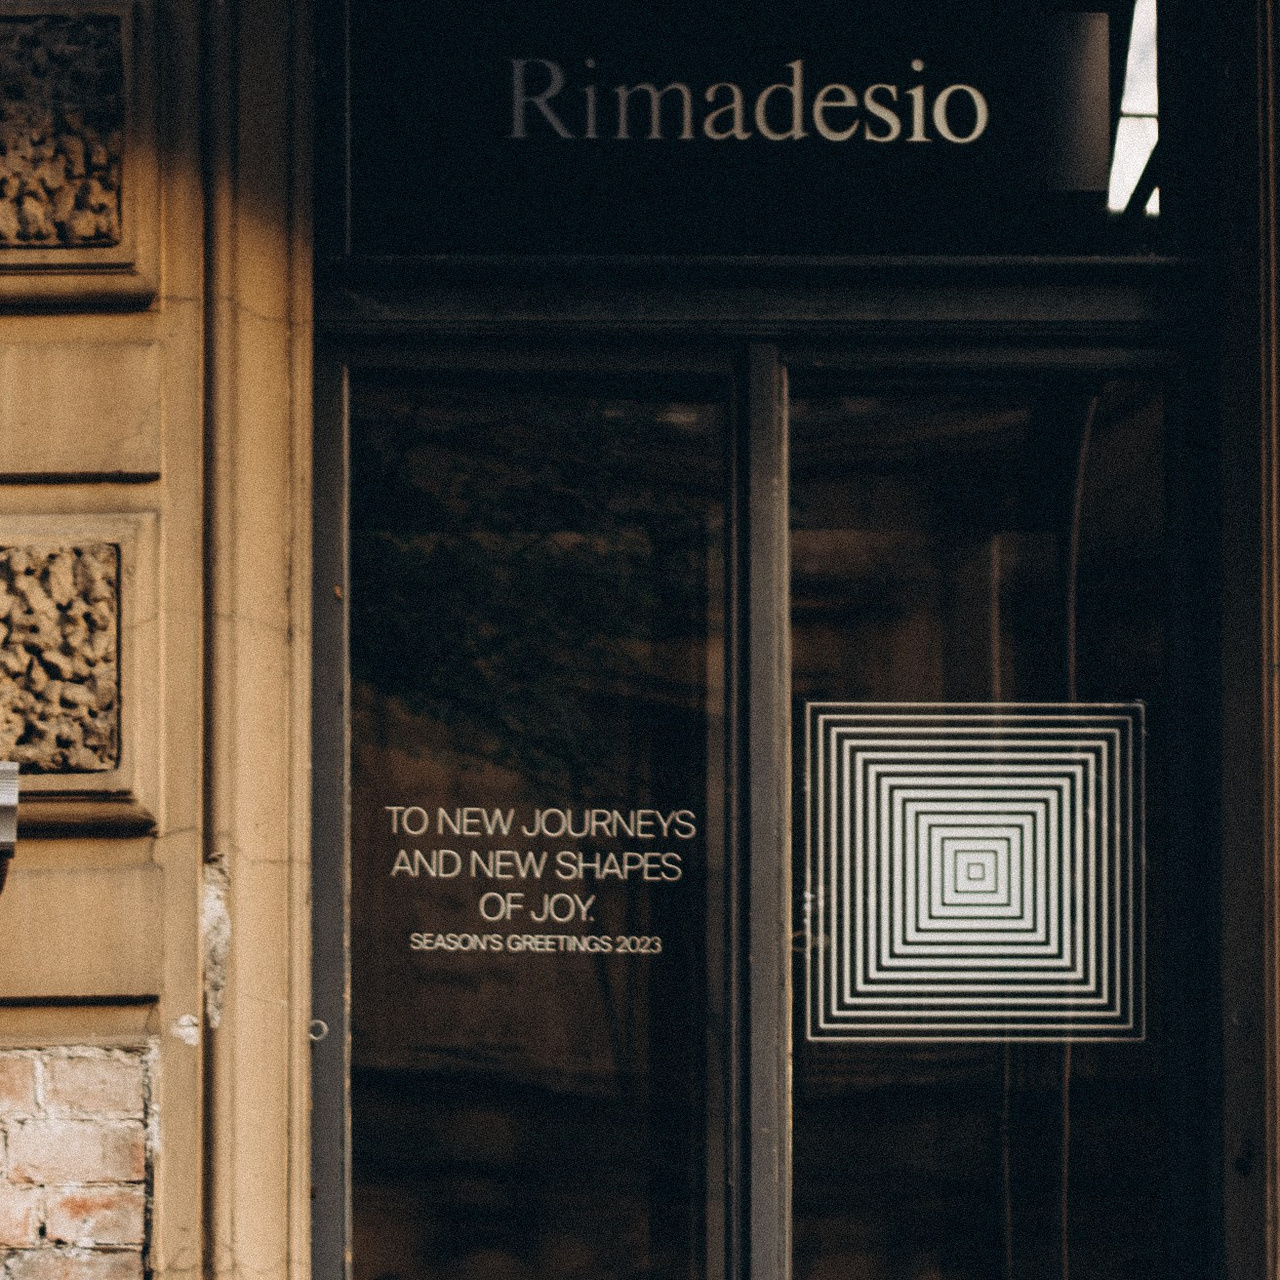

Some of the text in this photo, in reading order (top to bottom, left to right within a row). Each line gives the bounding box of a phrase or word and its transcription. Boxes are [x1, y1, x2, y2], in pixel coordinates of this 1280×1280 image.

[509, 58, 990, 144] Rimadesio
[384, 805, 697, 840] TO NEW JOURNEYS
[390, 849, 682, 882] AND NEW SHAPES
[478, 892, 596, 924] OF JOY.
[409, 932, 662, 955] SEASON'S GREETINGS 2023
